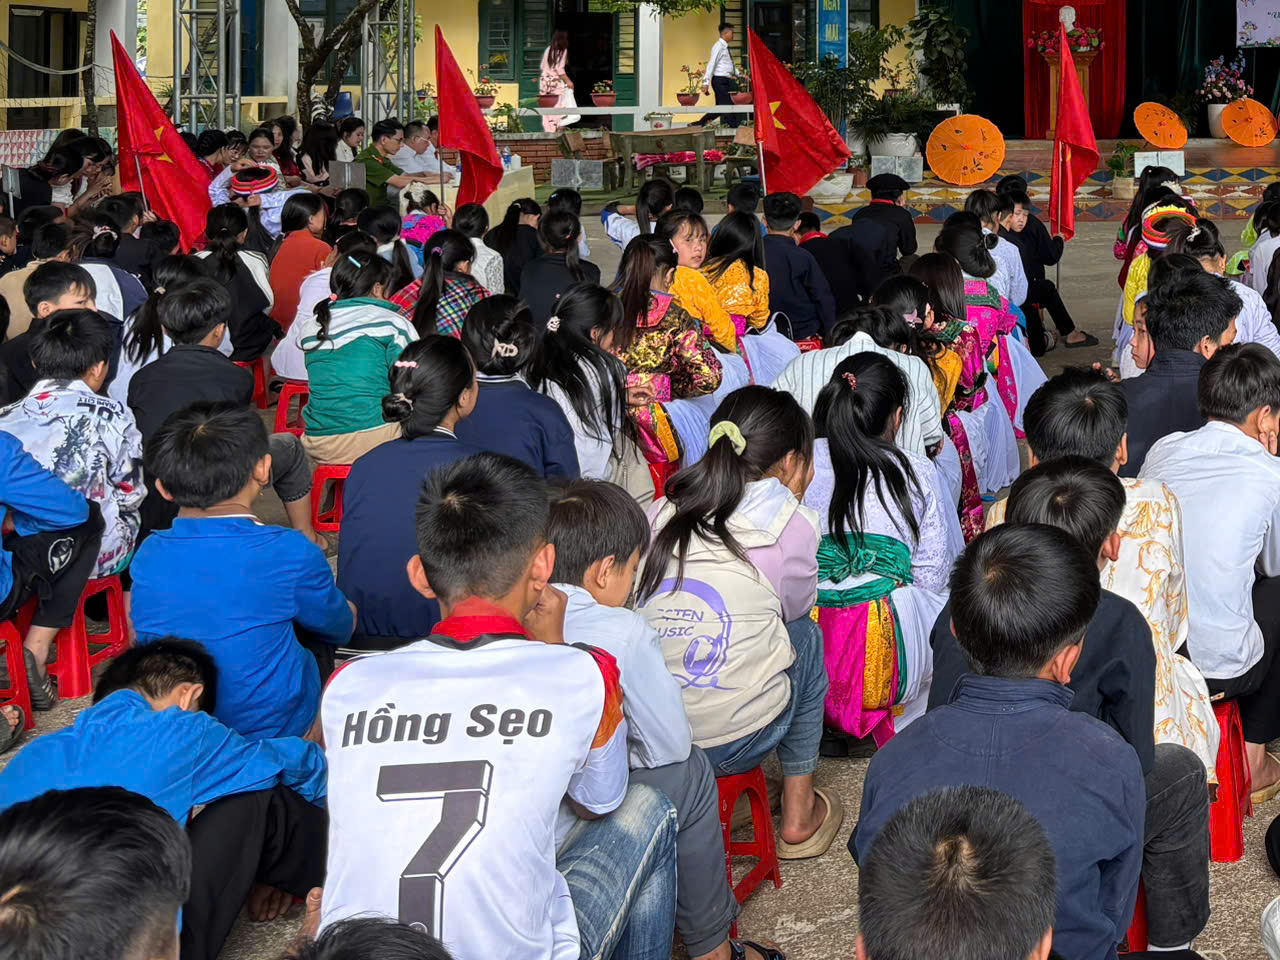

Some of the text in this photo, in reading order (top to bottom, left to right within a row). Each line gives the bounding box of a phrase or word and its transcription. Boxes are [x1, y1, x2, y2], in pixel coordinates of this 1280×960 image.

[825, 23, 839, 41] MAI
[341, 702, 553, 748] Hồng Sẹo
[375, 759, 494, 942] 7
